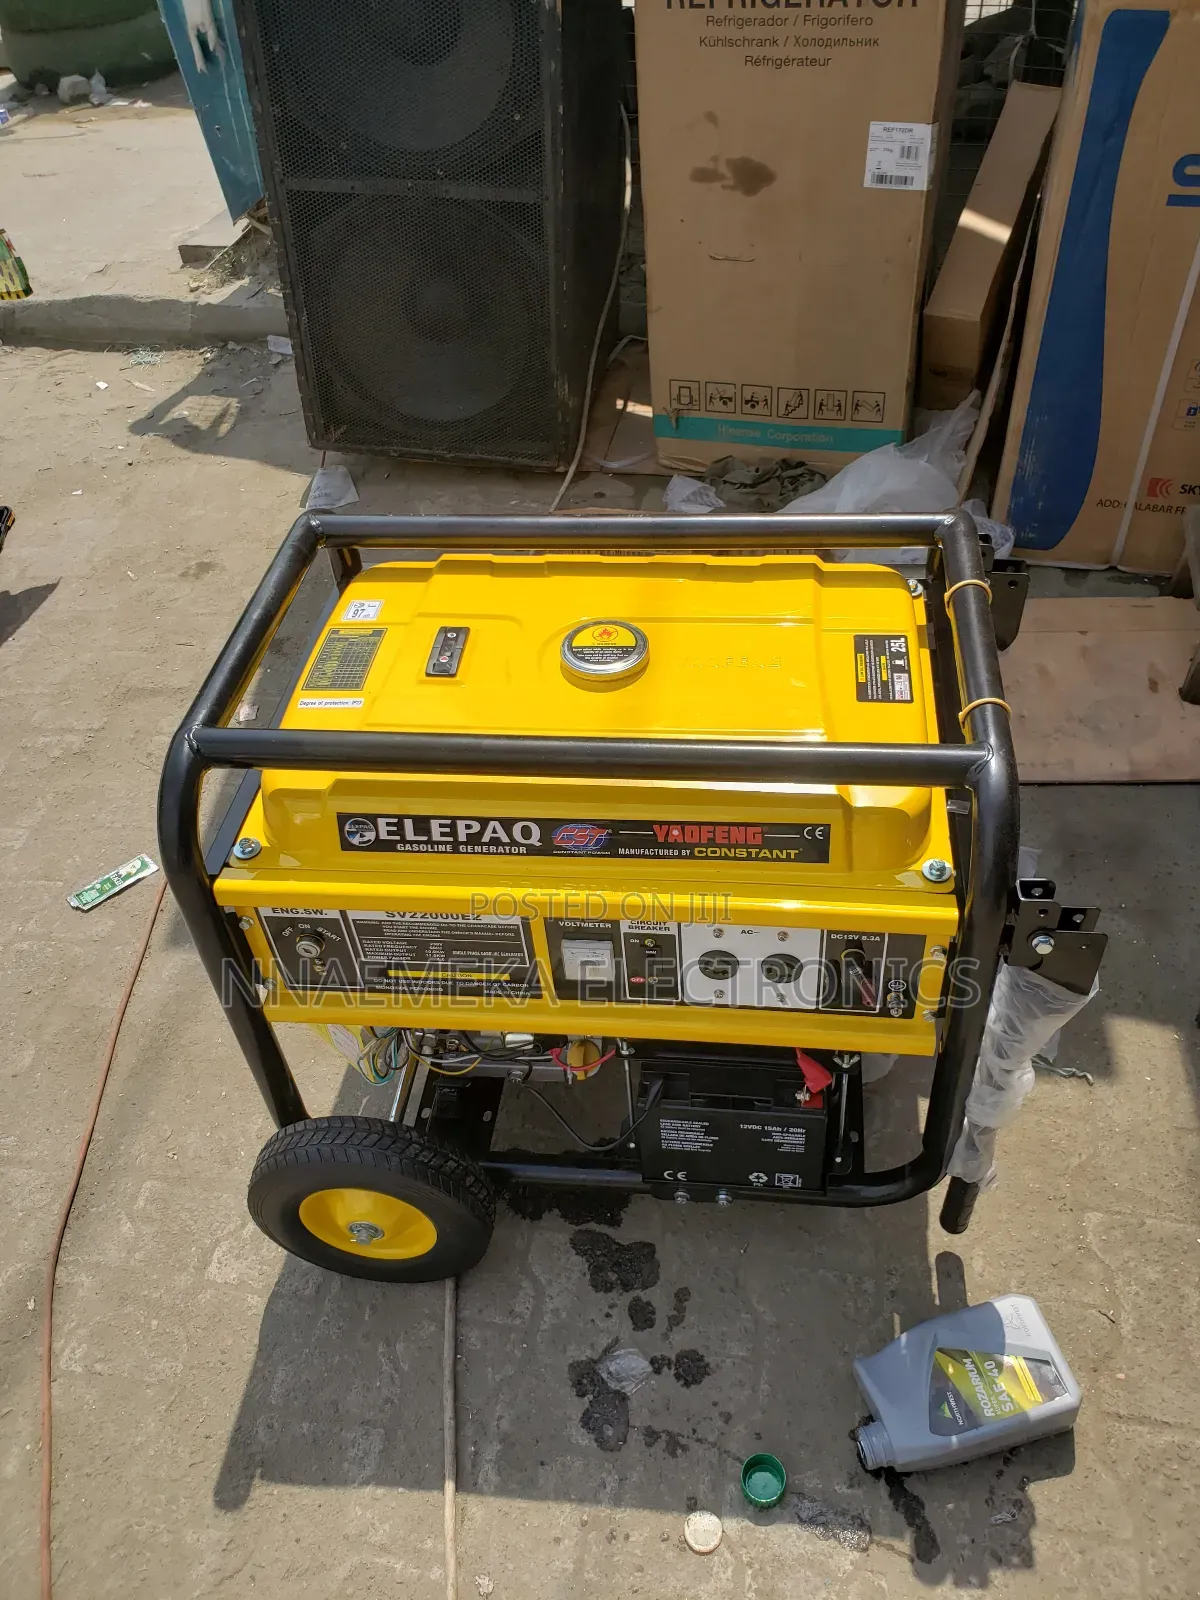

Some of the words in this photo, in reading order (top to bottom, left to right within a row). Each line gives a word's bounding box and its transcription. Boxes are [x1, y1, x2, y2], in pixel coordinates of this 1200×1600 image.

[707, 15, 789, 28] Refrigerador
[804, 14, 873, 29] Frigorifero
[700, 35, 779, 48] Kühlschrank
[794, 36, 879, 49] Холодильник
[745, 55, 832, 69] Réfrigérateur
[767, 429, 833, 444] Corporation
[1096, 499, 1122, 509] ADD:
[352, 608, 366, 618] 97
[890, 637, 906, 653] 25L
[376, 817, 542, 846] ELEPAQ
[553, 827, 608, 846] CST
[653, 824, 762, 845] YAOFENG
[397, 843, 453, 852] GASOLINE
[460, 845, 527, 854] GENERATOR
[619, 847, 679, 856] MANUFACTURED
[694, 847, 799, 859] CONSTANT
[282, 926, 294, 937] OFF
[317, 927, 341, 942] START
[831, 933, 860, 941] DC12V
[962, 1358, 995, 1417] ROZARIUM
[946, 1390, 964, 1426] NORTHWEST
